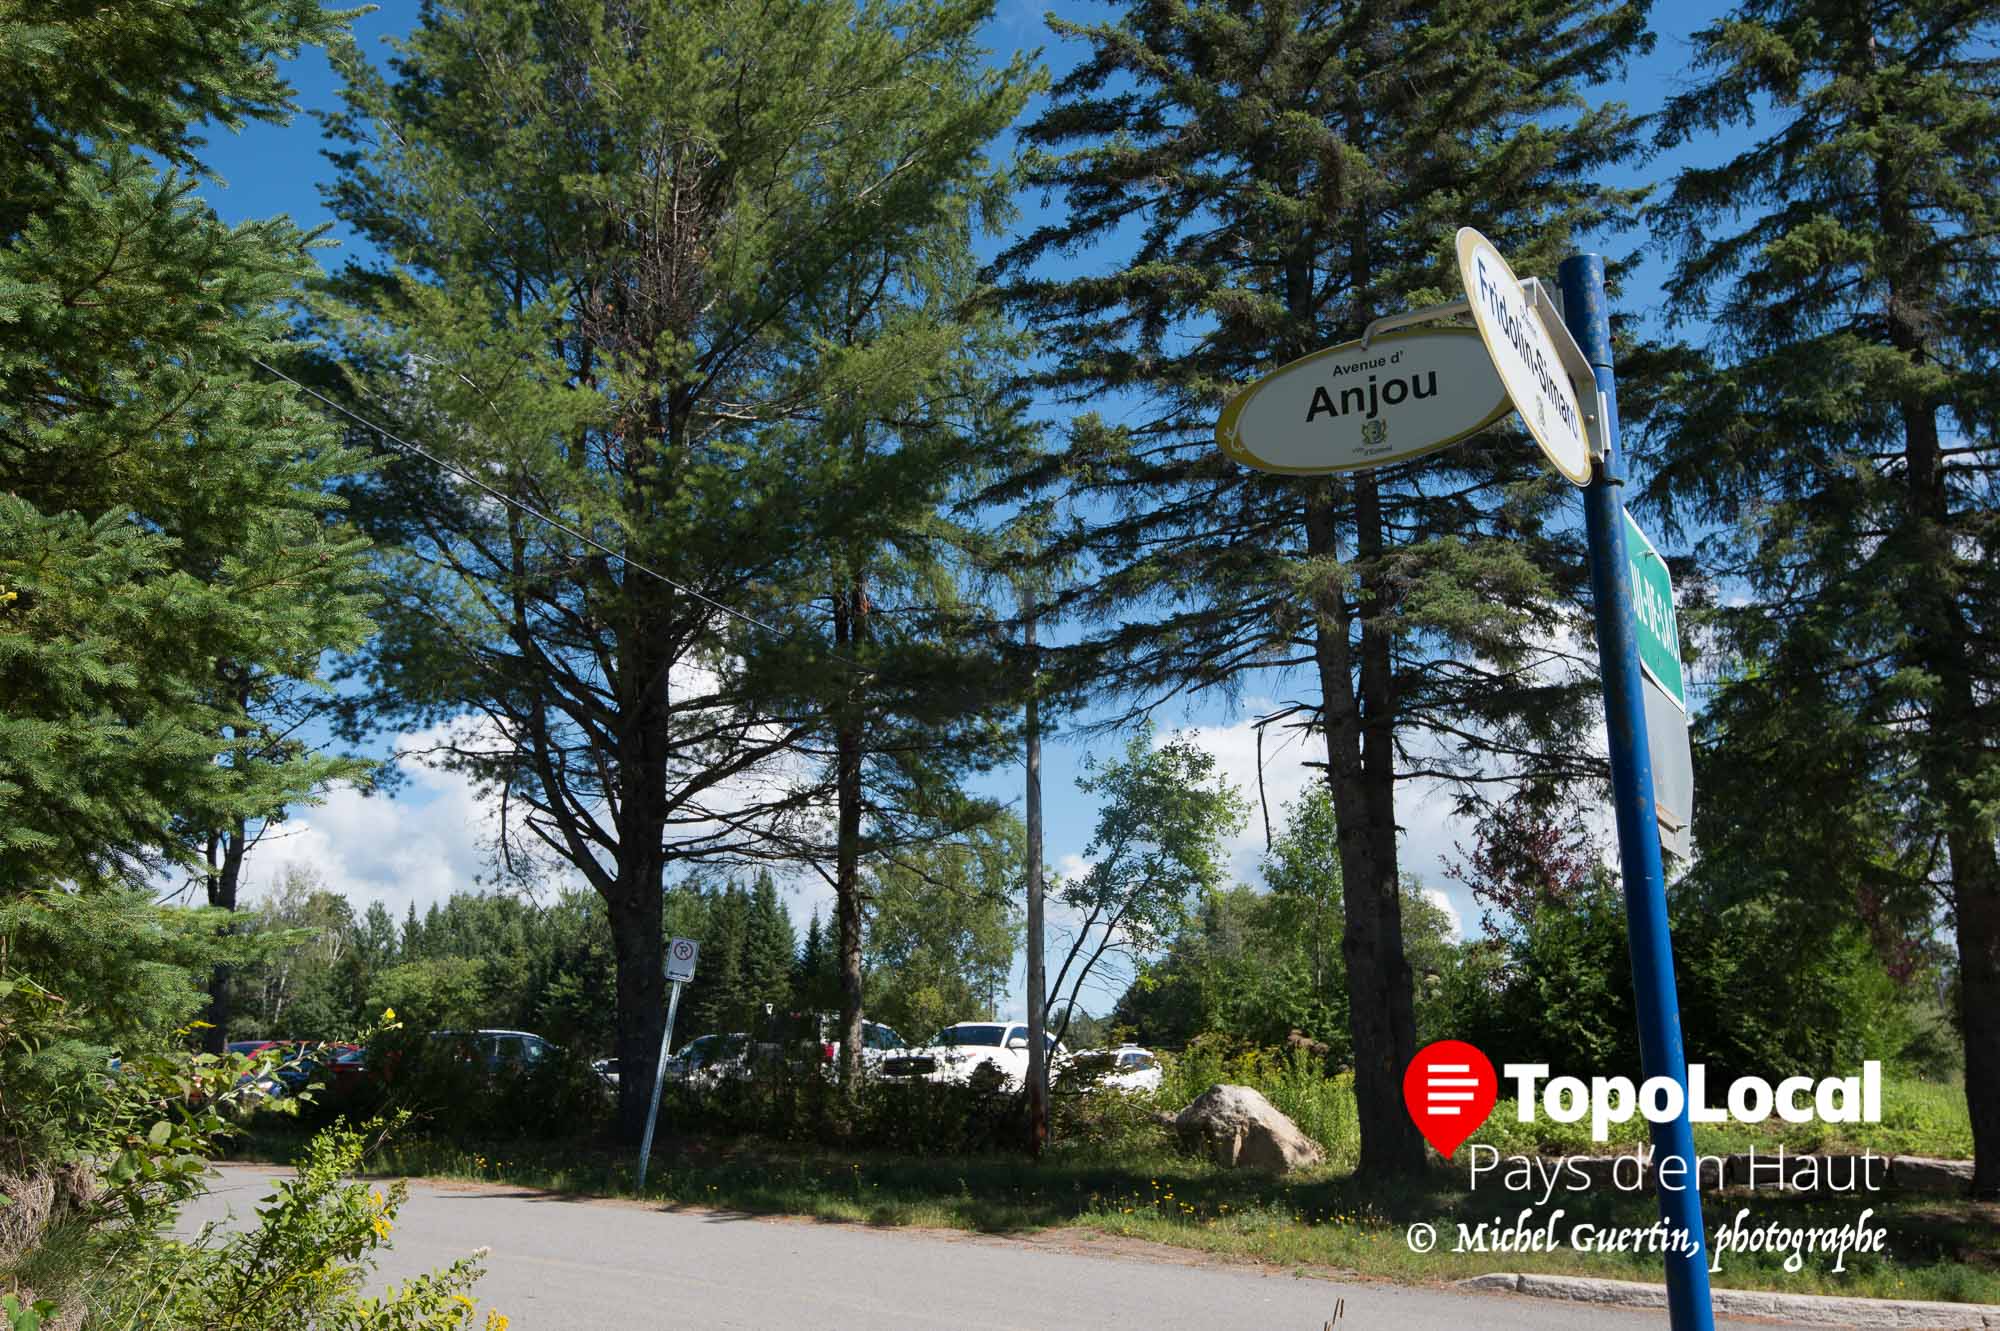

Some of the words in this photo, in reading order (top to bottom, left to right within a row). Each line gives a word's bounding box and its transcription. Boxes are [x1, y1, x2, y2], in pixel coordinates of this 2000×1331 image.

[1332, 357, 1386, 377] Avenue
[1477, 255, 1579, 440] Fridolin-Simard
[1305, 370, 1438, 423] Anjou
[1629, 559, 1679, 663] UL-DE-SAC
